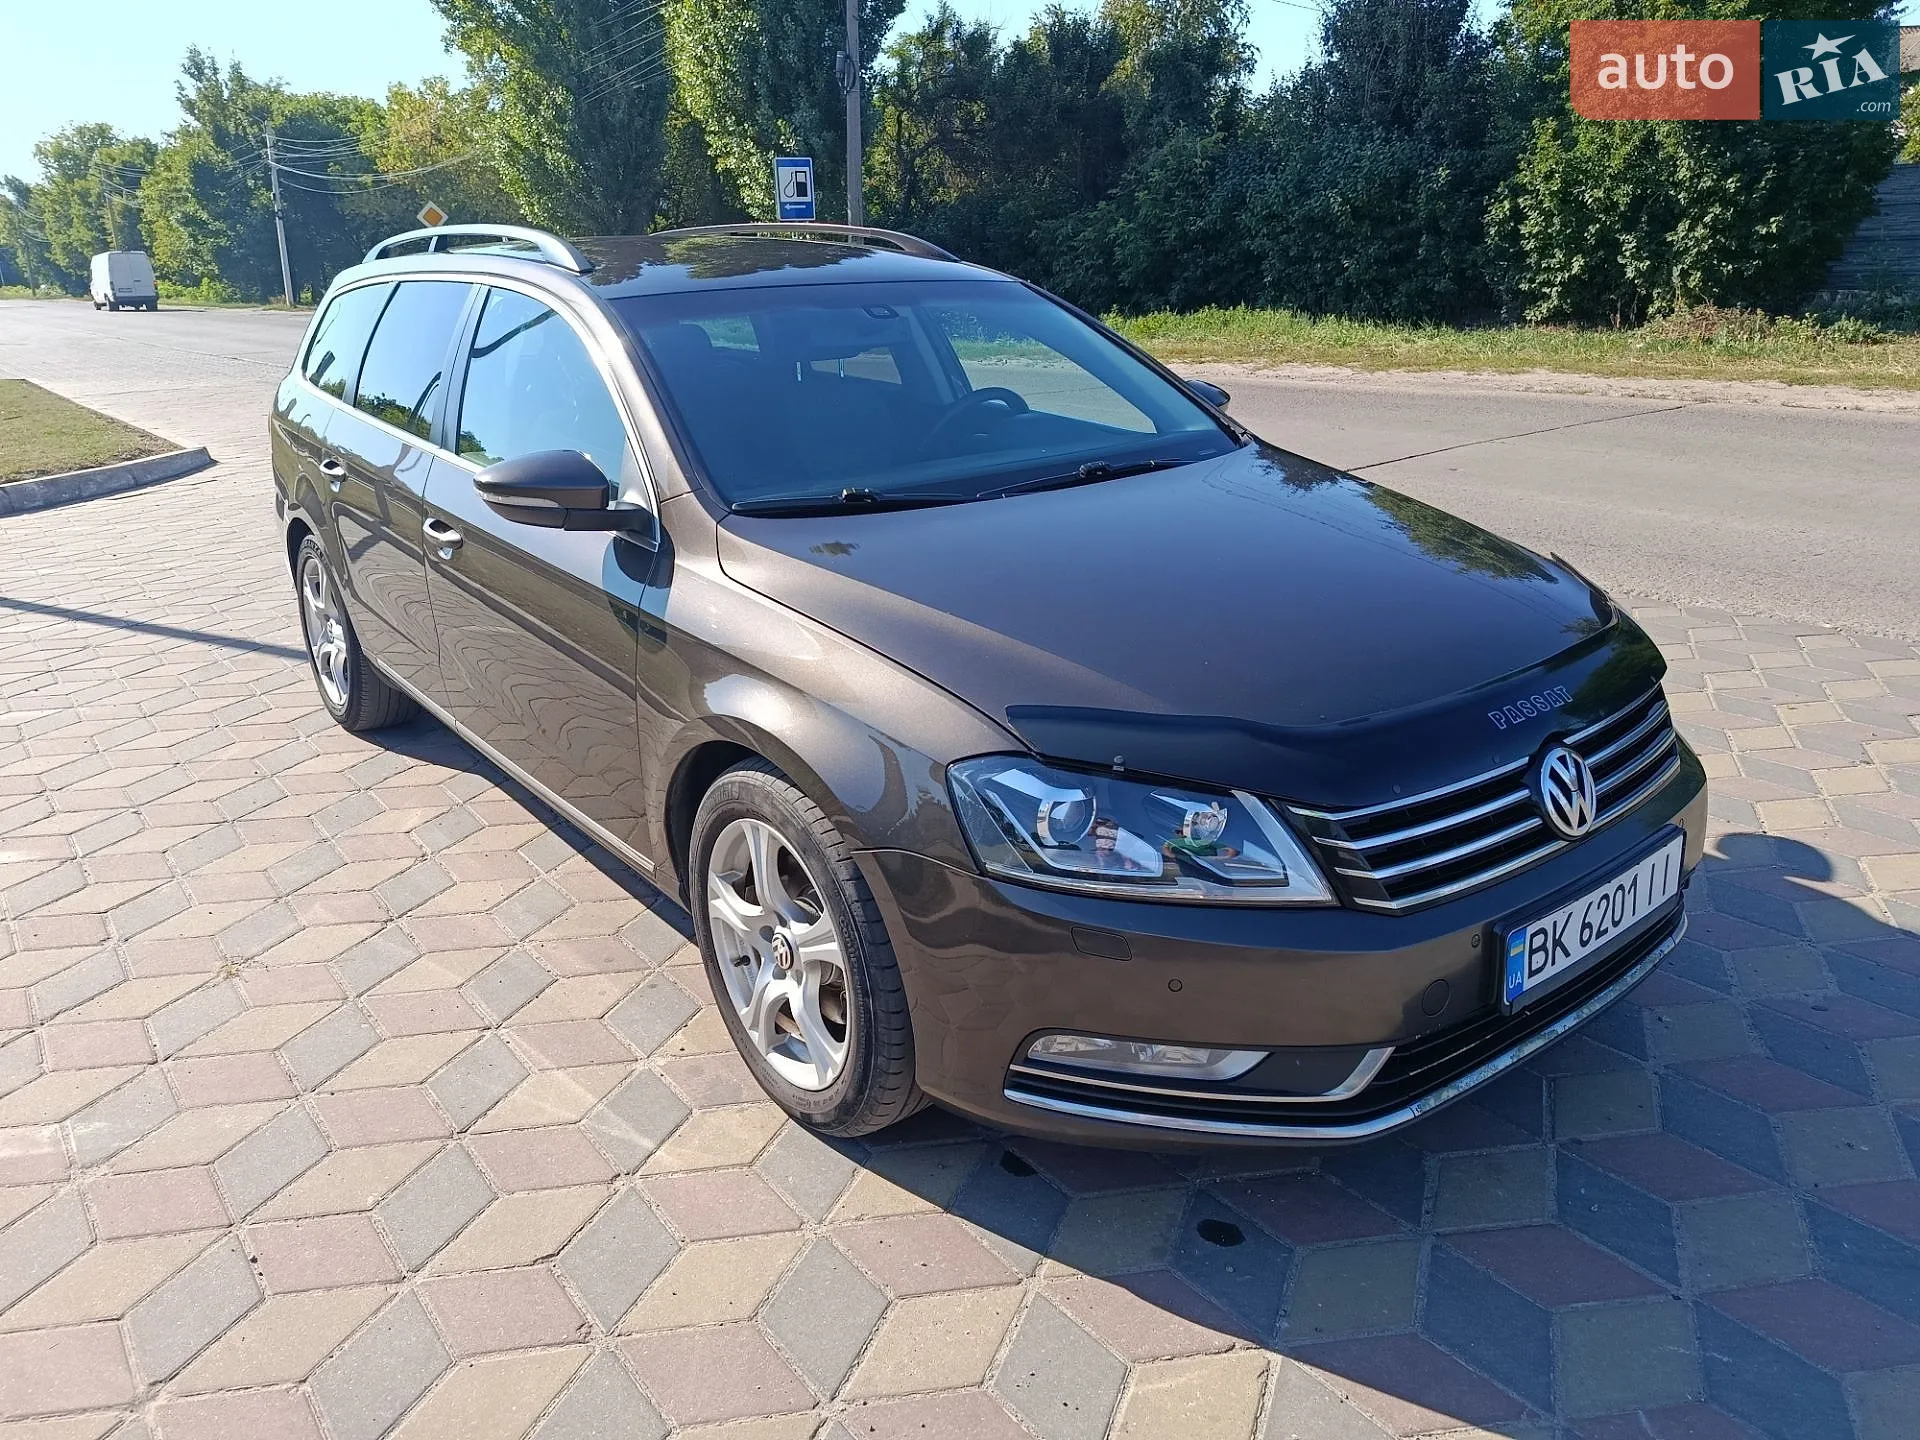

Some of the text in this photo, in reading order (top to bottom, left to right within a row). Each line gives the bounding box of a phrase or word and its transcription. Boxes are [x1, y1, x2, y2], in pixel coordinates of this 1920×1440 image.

[1487, 684, 1573, 730] PASSAT
[1527, 911, 1574, 980] BK
[1578, 872, 1639, 948] 6201
[1508, 970, 1523, 990] UA
